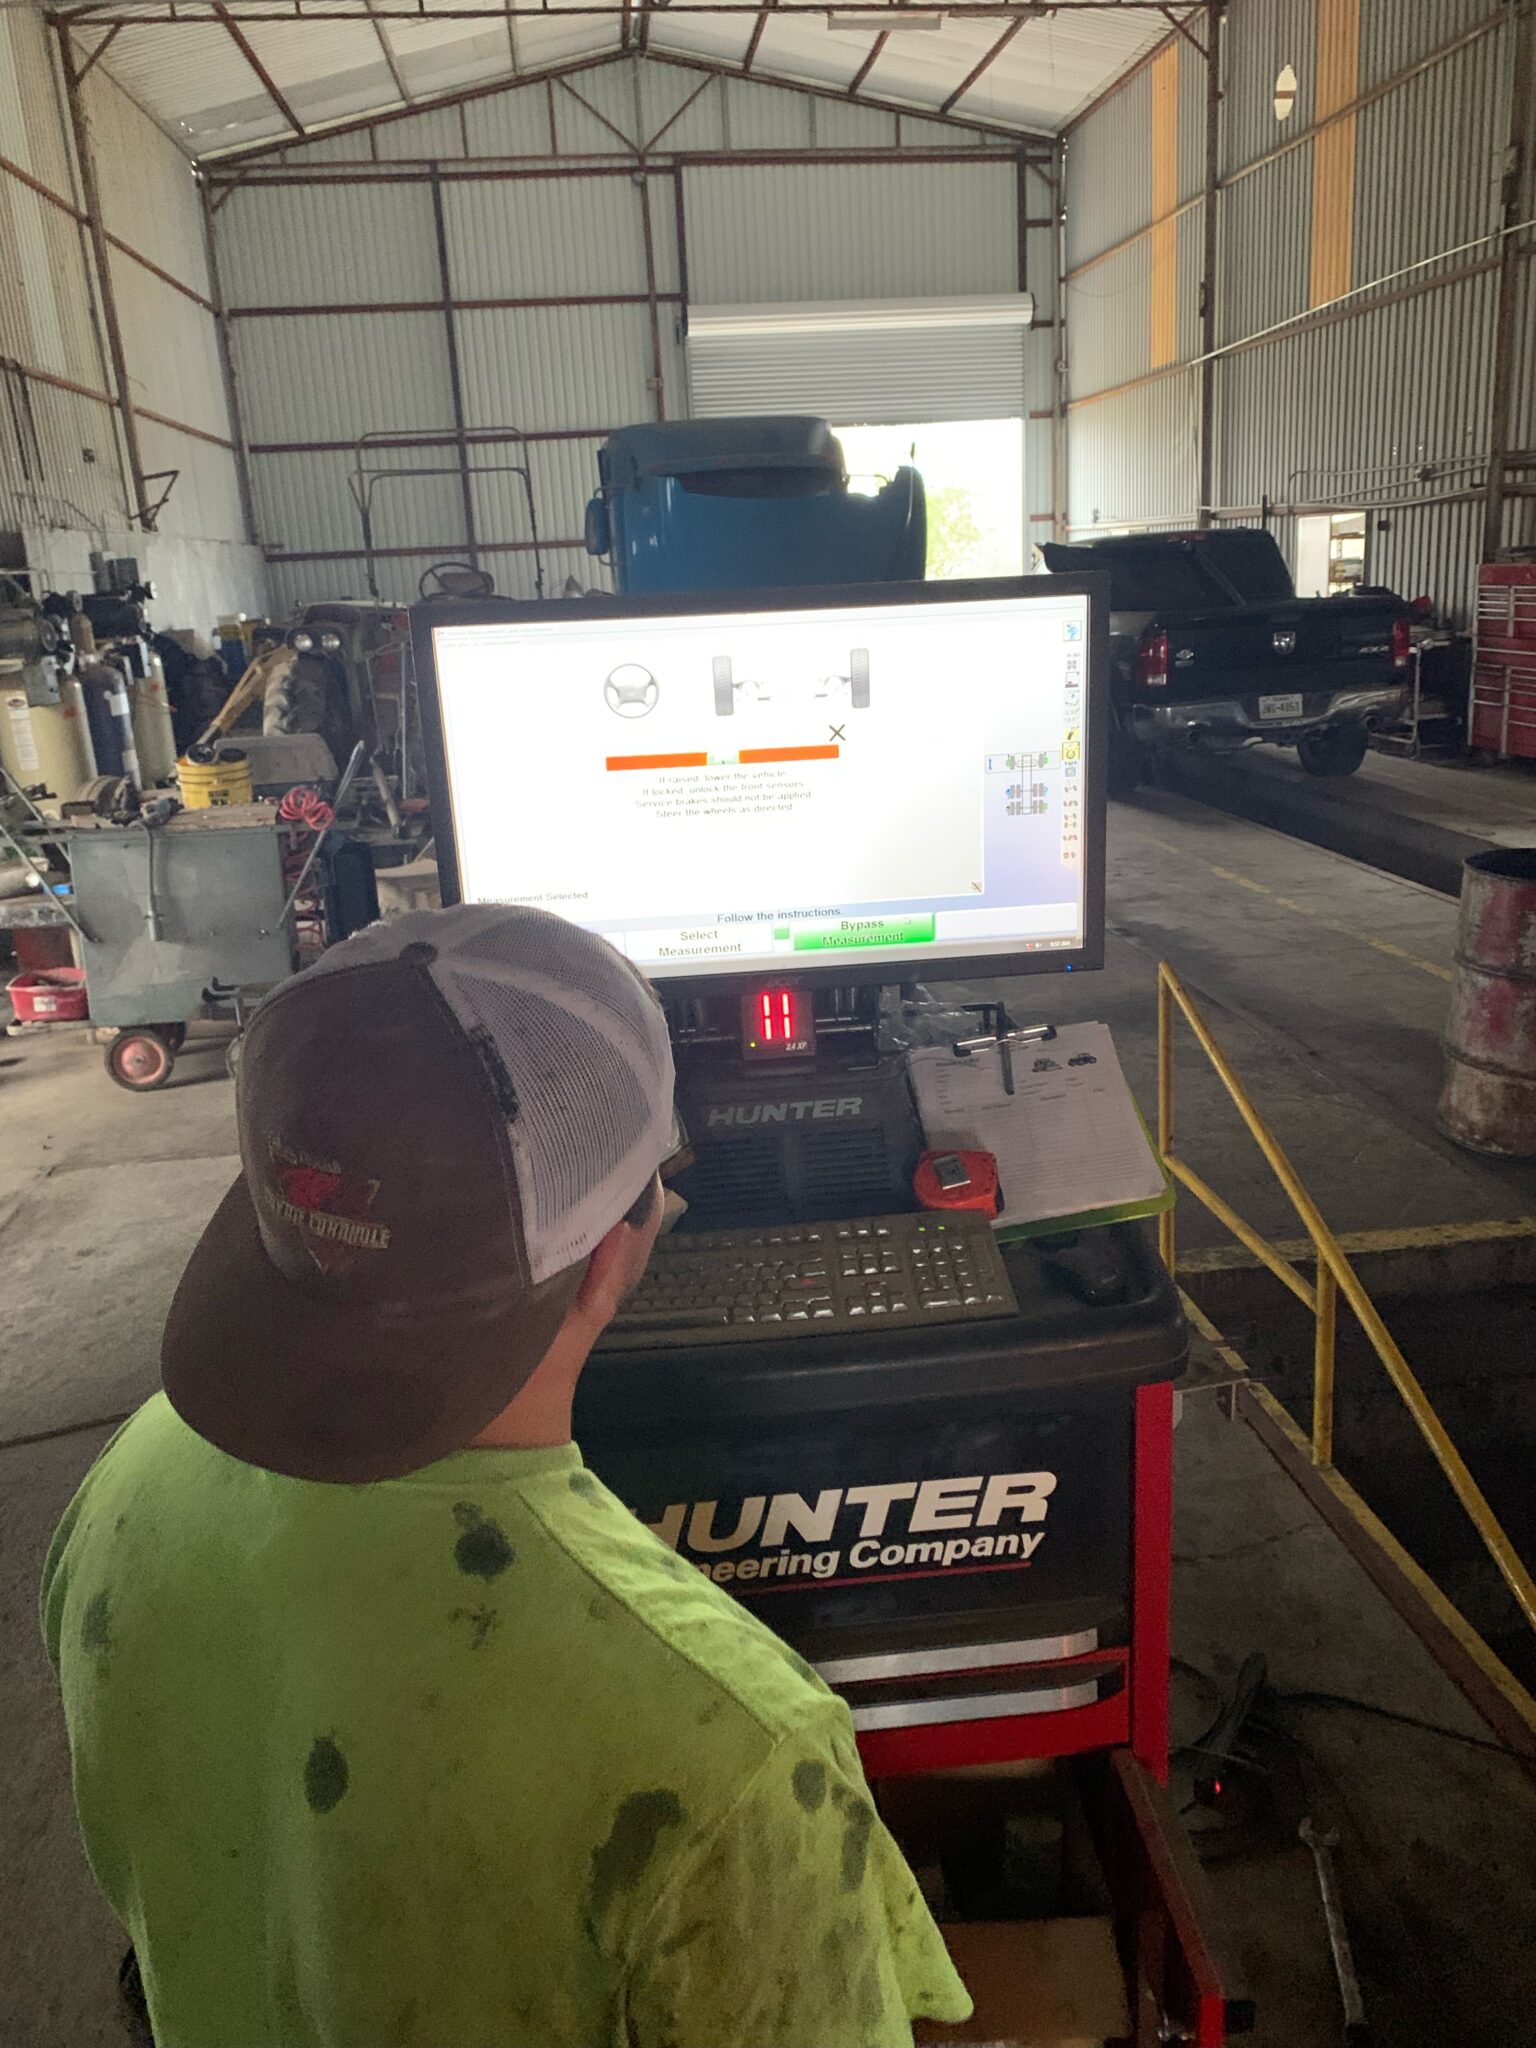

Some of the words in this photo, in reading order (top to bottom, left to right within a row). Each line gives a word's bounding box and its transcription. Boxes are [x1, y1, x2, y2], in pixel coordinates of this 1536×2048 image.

[705, 773, 730, 782] lower
[734, 772, 749, 781] the
[752, 770, 786, 779] vehicle
[689, 785, 720, 794] unlock
[723, 784, 738, 792] the
[741, 782, 763, 791] front
[635, 799, 673, 809] Service
[675, 797, 709, 807] brakes
[711, 795, 743, 804] should
[745, 794, 760, 802] not
[762, 793, 775, 801] be
[656, 809, 683, 819] Steer
[685, 808, 700, 817] the
[703, 806, 736, 816] wheels
[739, 806, 751, 814] as
[477, 894, 543, 905] Measurement
[546, 891, 589, 902] Selected
[717, 912, 754, 924] Follow
[756, 910, 774, 921] the
[840, 919, 885, 932] Bypass
[680, 930, 719, 942] Select
[822, 931, 905, 946] Measurement
[658, 943, 742, 958] Measurement
[707, 1096, 863, 1127] HUNTER
[848, 1531, 1046, 1569] Company
